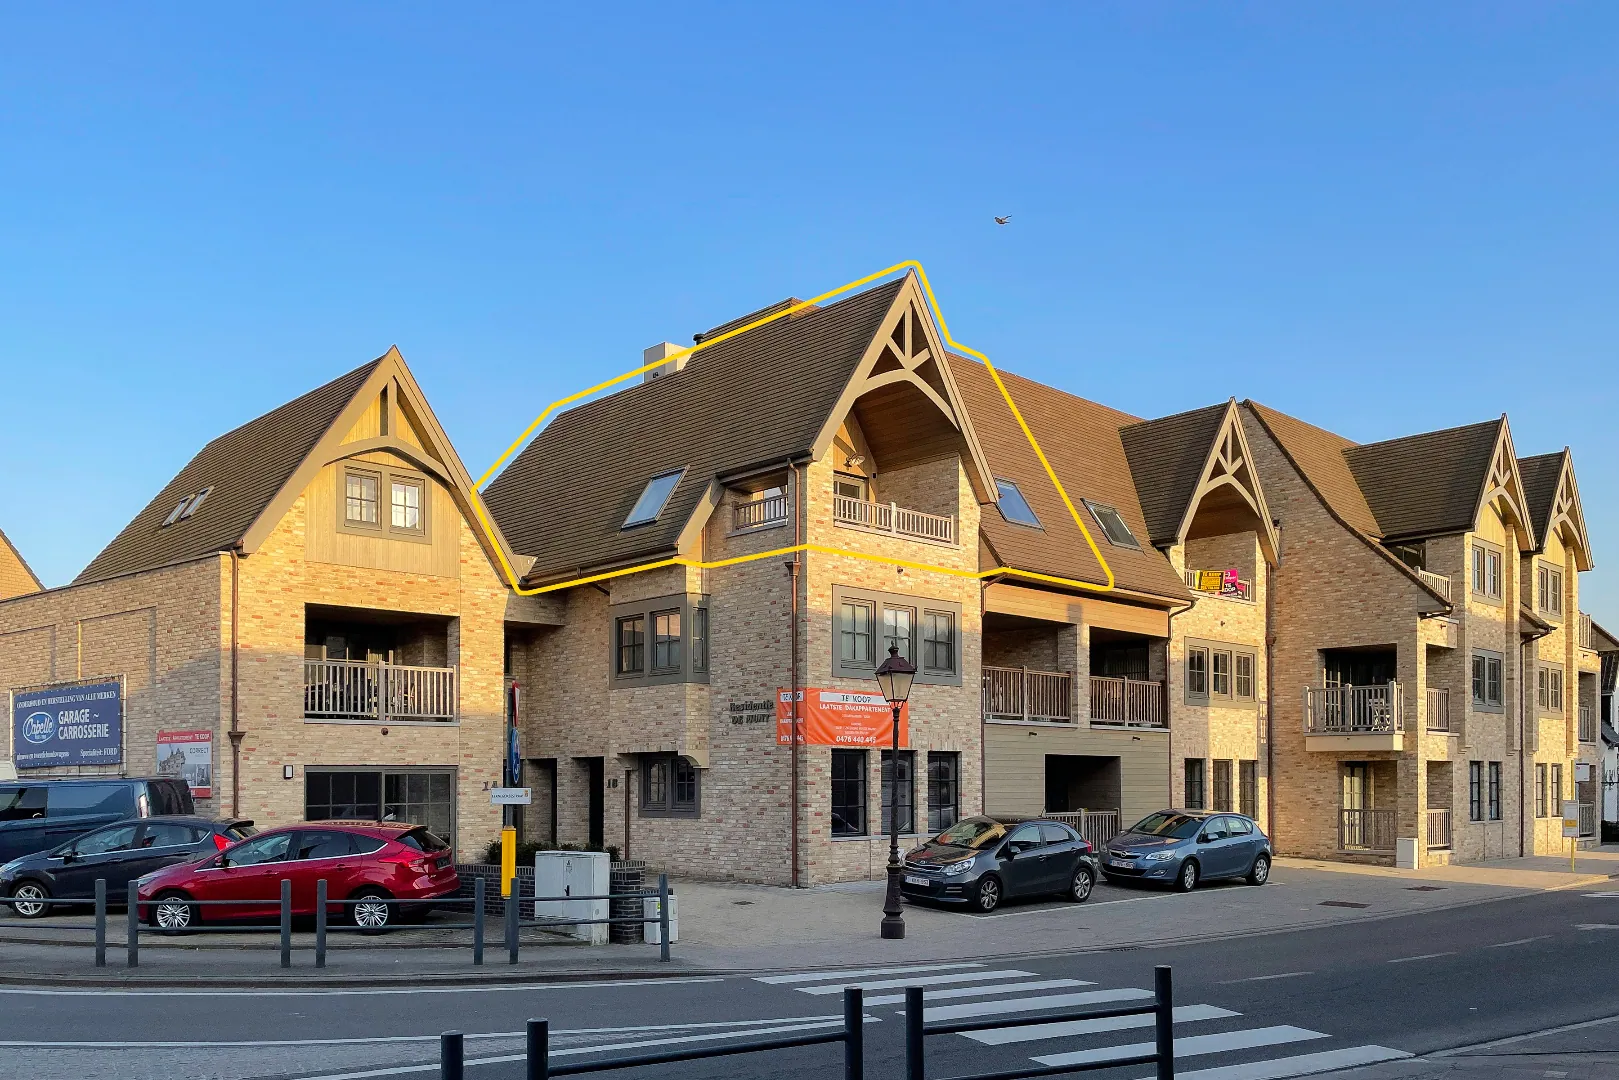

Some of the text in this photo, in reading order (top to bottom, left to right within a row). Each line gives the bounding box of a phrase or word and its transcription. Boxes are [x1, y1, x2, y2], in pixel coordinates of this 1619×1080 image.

[841, 694, 872, 703] TE KOOP
[730, 700, 774, 712] Residentie
[845, 705, 891, 713] DAKAPPARTEMENT
[58, 709, 90, 724] GARAGE
[732, 715, 744, 724] DE
[58, 724, 109, 740] CARROSSERIE
[836, 735, 852, 743] 0476
